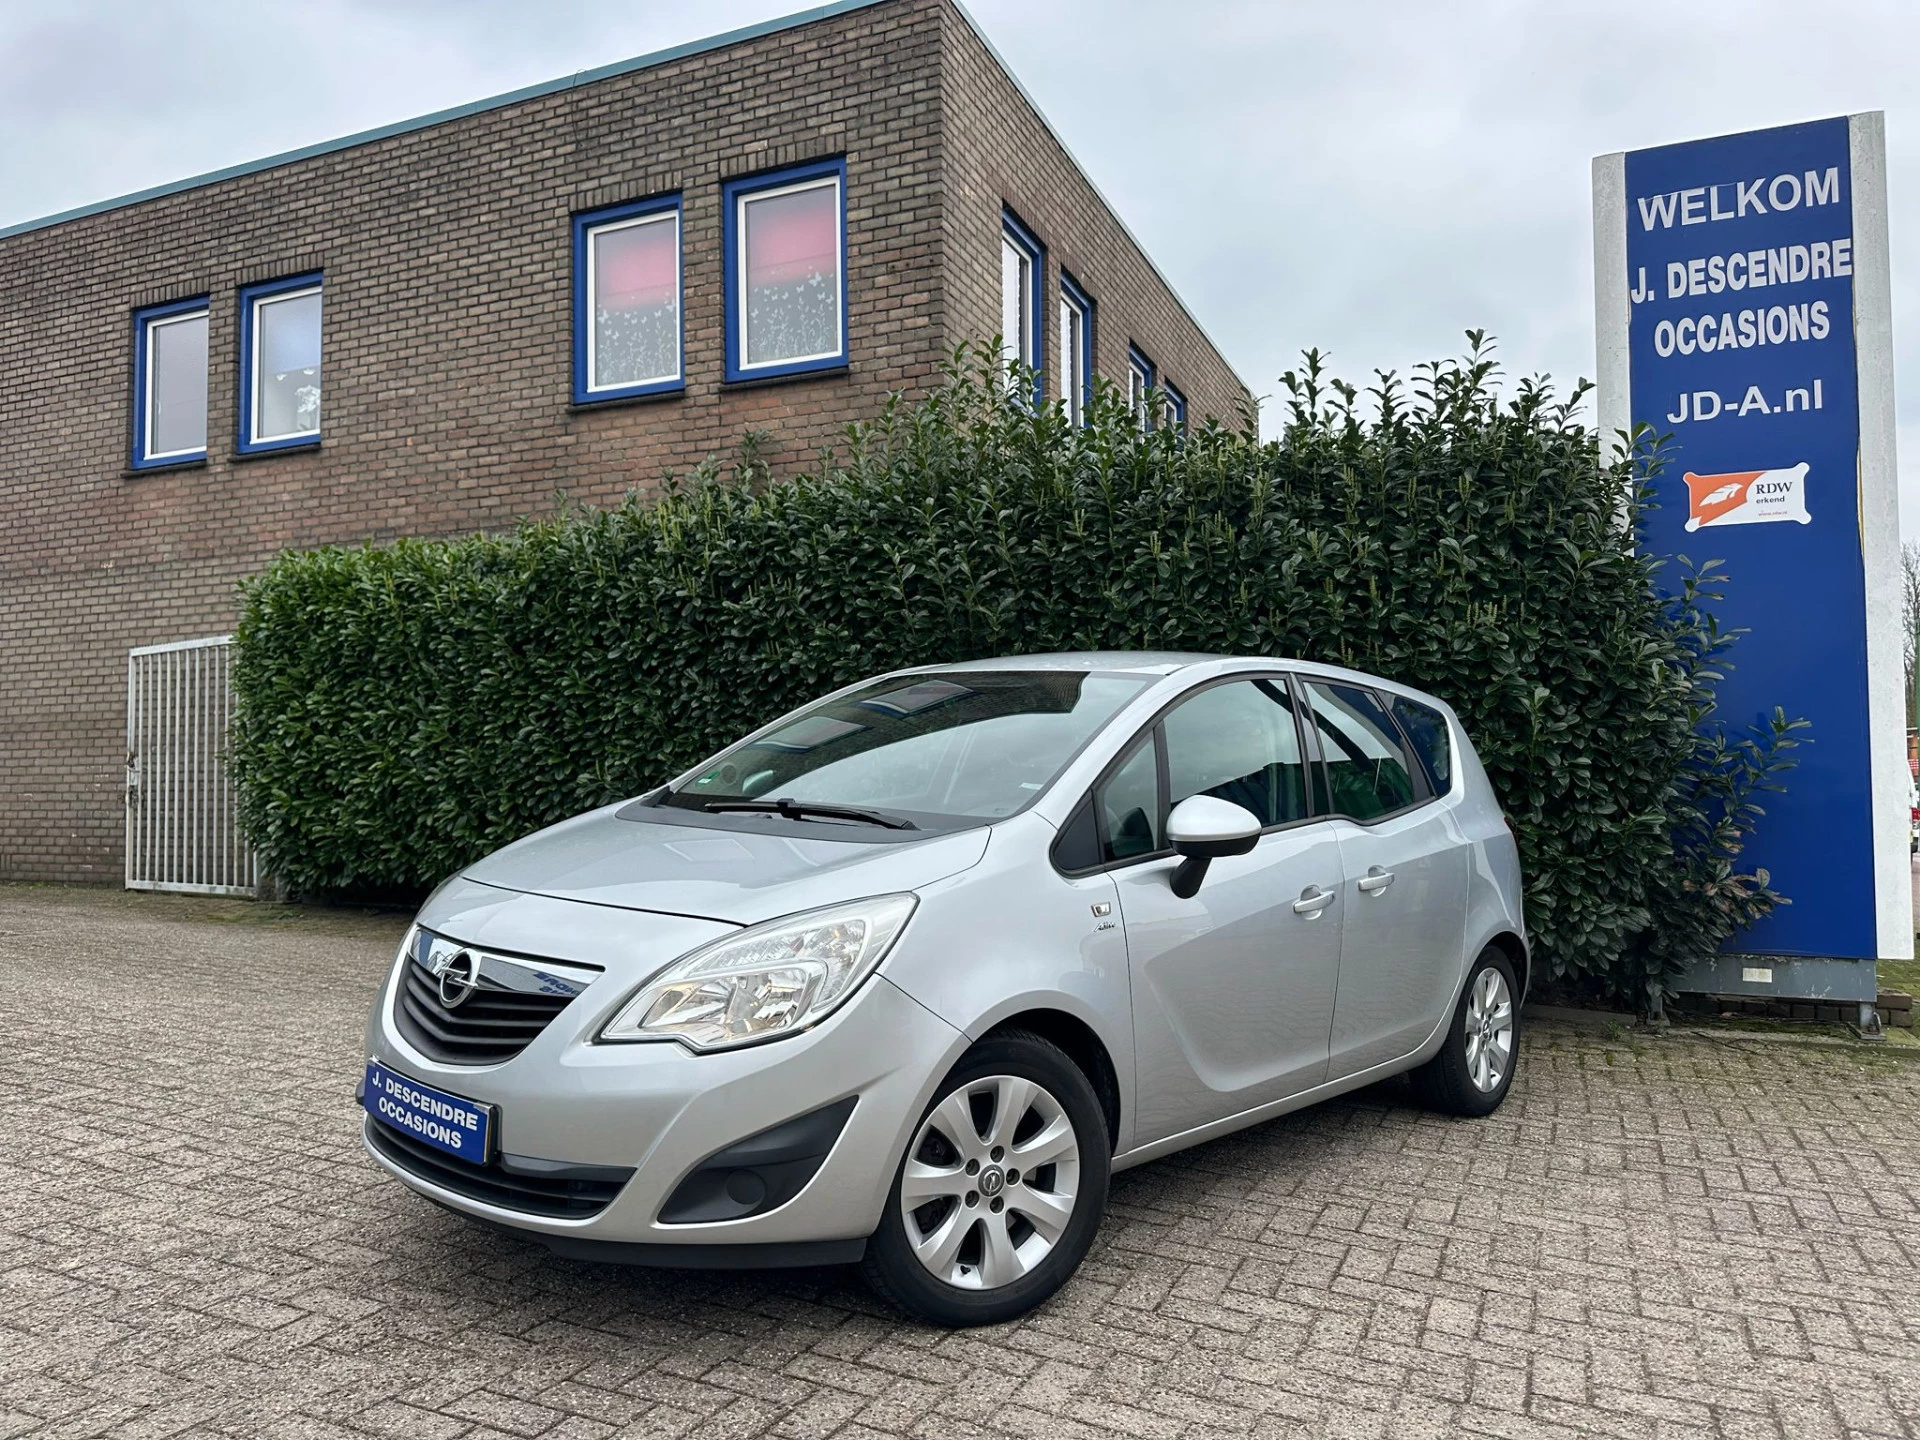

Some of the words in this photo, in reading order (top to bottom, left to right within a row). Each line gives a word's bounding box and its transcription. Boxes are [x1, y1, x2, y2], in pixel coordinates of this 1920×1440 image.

[1637, 166, 1840, 232] WELKOM
[1630, 266, 1655, 304] J.
[1667, 238, 1853, 299] DESCENDRE
[1654, 300, 1830, 358] OCCASIONS
[1666, 379, 1823, 424] JD-A.nl
[1755, 481, 1793, 495] RDW
[1755, 495, 1786, 504] erkend
[371, 1071, 382, 1088] J.
[385, 1077, 478, 1131] DESCENDRE
[378, 1096, 462, 1149] OCCASIONS
